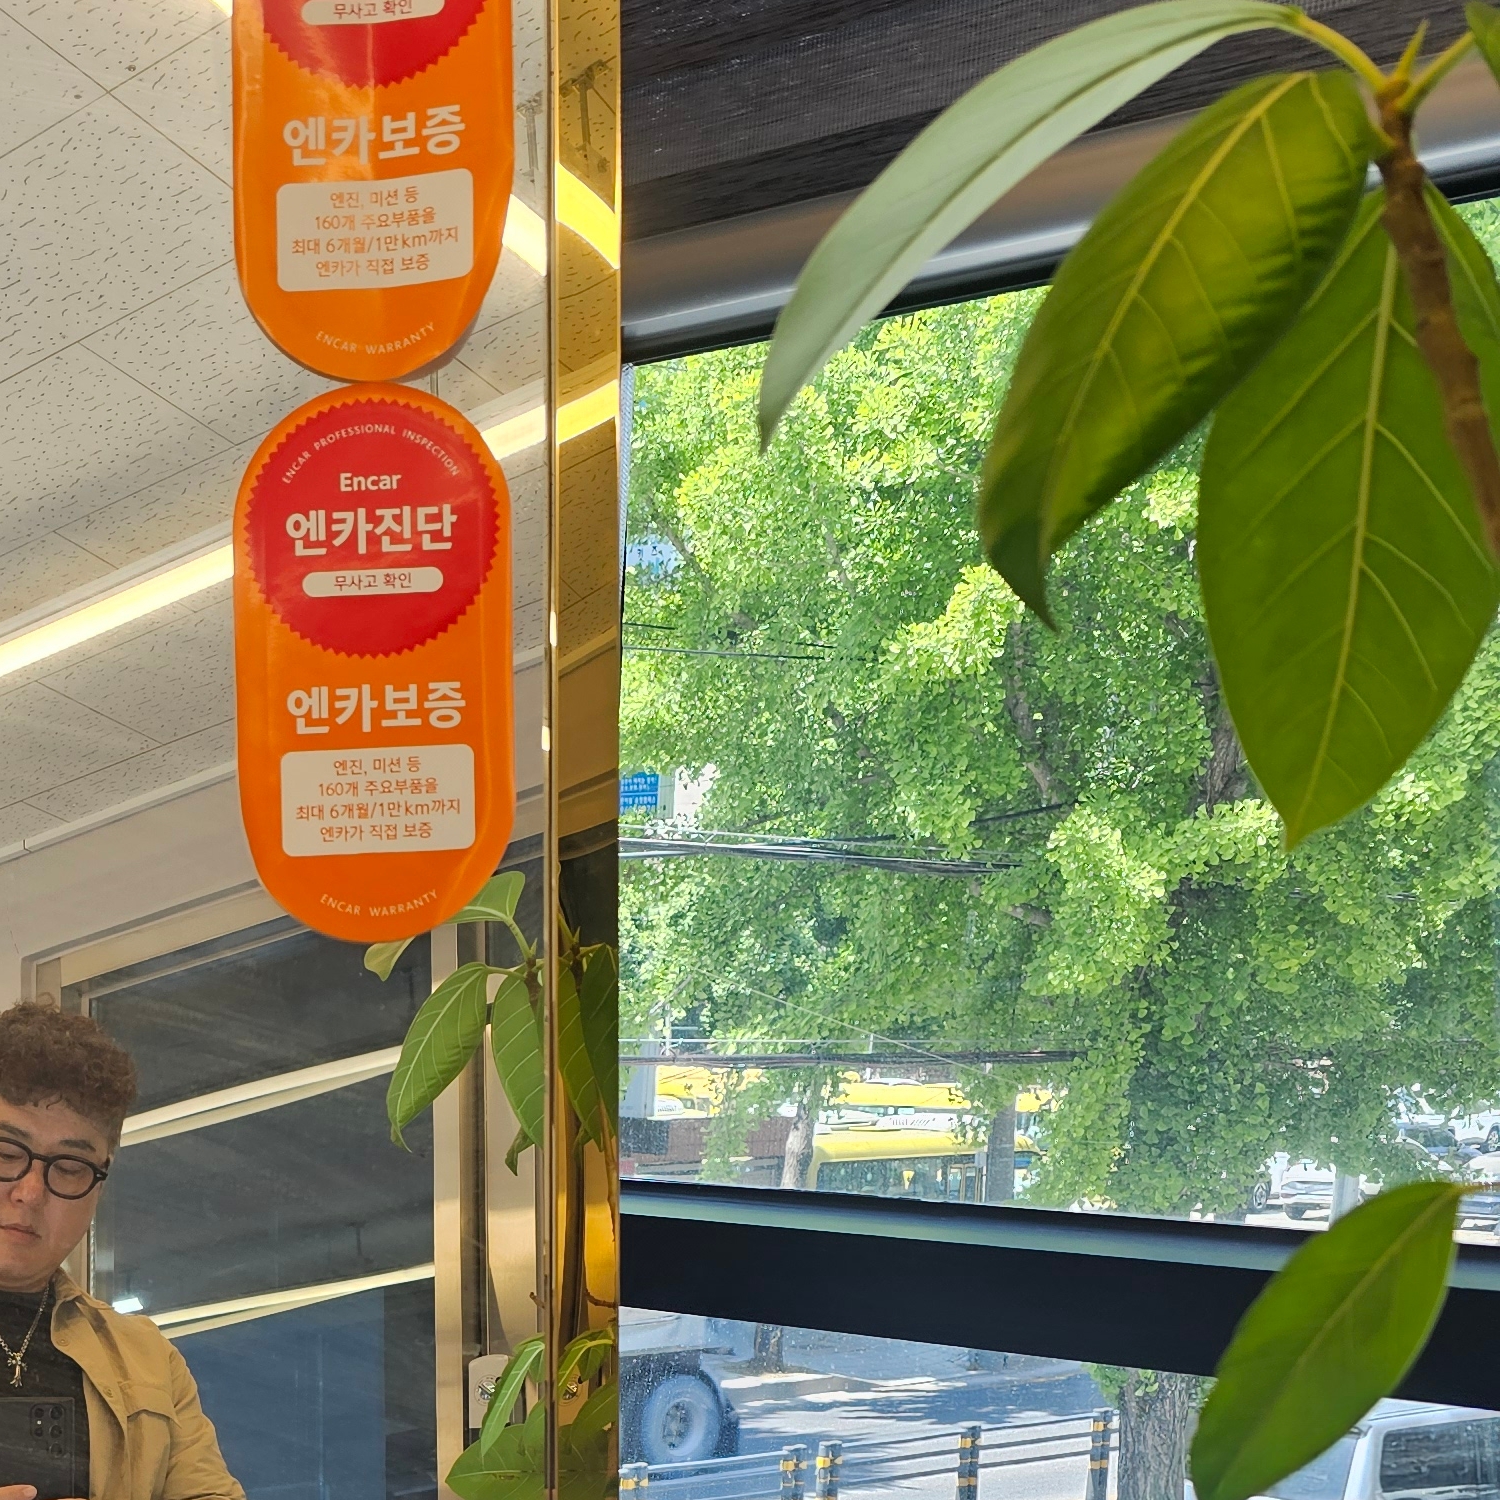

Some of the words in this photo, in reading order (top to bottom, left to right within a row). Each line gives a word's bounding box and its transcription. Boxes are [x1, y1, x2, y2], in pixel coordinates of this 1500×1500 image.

[333, 2, 377, 19] 무사고
[382, 1, 413, 17] 확인
[283, 104, 466, 166] 엔카보증
[329, 192, 365, 209] 엔진,
[369, 189, 399, 206] 미션
[404, 186, 419, 203] 등
[315, 213, 356, 231] 160개
[360, 206, 436, 228] 주요부품을
[291, 238, 321, 256] 최대
[315, 261, 361, 278] 엔카가
[365, 258, 395, 275] 직접
[400, 253, 431, 272] 보증
[315, 330, 357, 354] ENCAR
[365, 322, 436, 355] WARRANTY
[282, 450, 312, 484] ENCAR
[313, 424, 397, 451] PROFESSIONAL
[402, 429, 460, 477] INSPECTION
[339, 472, 402, 492] Encar
[285, 504, 458, 557] 엔카진단
[333, 574, 378, 591] 무사고
[382, 572, 413, 589] 확인
[286, 681, 466, 735] 엔카보증
[333, 759, 368, 777] 엔진,
[373, 757, 401, 773] 미션
[407, 756, 421, 772] 등
[318, 780, 359, 798] 160개
[364, 777, 439, 795] 주요부품을
[295, 804, 325, 821] 최대
[320, 825, 364, 842] 엔카가
[369, 823, 398, 840] 직접
[403, 822, 433, 839] 보증
[320, 893, 361, 916] ENCAR
[368, 888, 438, 917] WARRANTY
